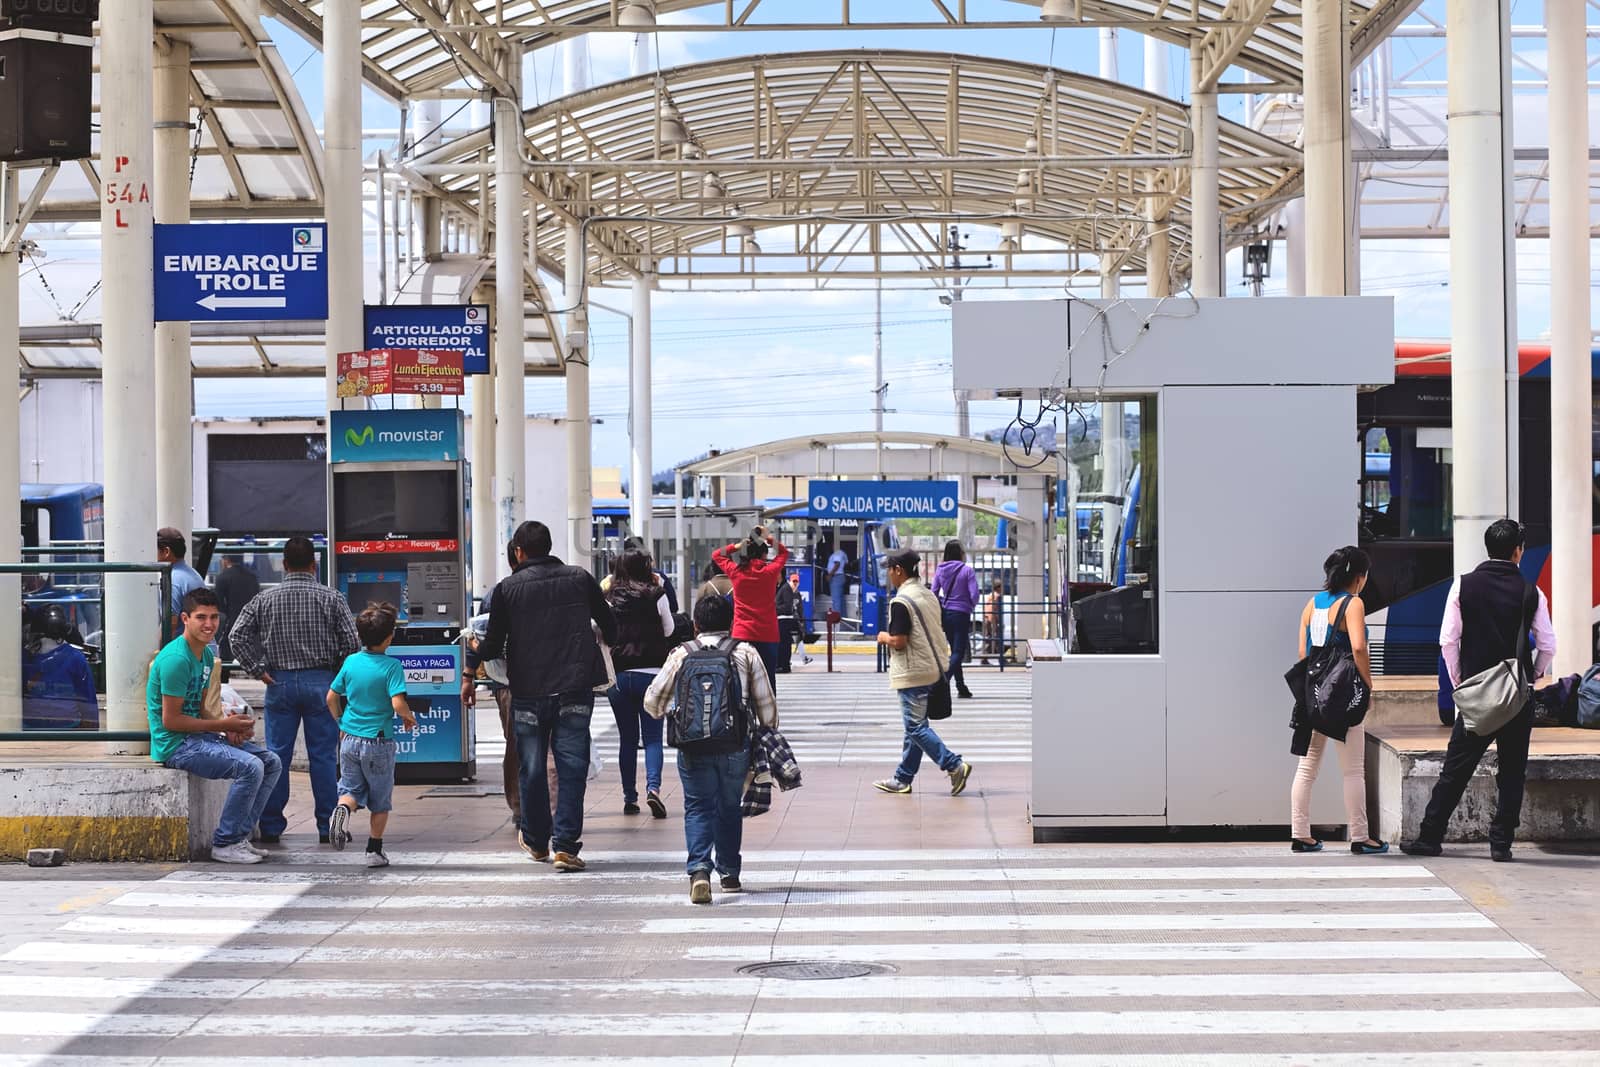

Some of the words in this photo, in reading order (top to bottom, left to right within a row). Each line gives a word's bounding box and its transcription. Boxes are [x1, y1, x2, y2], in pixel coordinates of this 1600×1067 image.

[115, 156, 129, 173] P
[116, 209, 129, 228] L
[164, 254, 318, 272] EMBARQUE
[195, 273, 286, 291] TROLE
[372, 325, 484, 335] ARTICULADOS
[385, 336, 472, 346] CORREDOR
[394, 363, 420, 374] Lunch
[421, 364, 462, 377] Ejecutivo
[378, 429, 444, 442] movistar
[832, 496, 874, 513] SALIDA
[877, 496, 937, 513] PEATONAL
[591, 515, 613, 525] LIDA
[817, 518, 859, 527] ENTRADA
[341, 544, 366, 553] Claro
[401, 659, 422, 668] ARGA
[423, 659, 429, 667] Y
[430, 659, 451, 667] PAGA
[407, 670, 428, 681] AQUÍ
